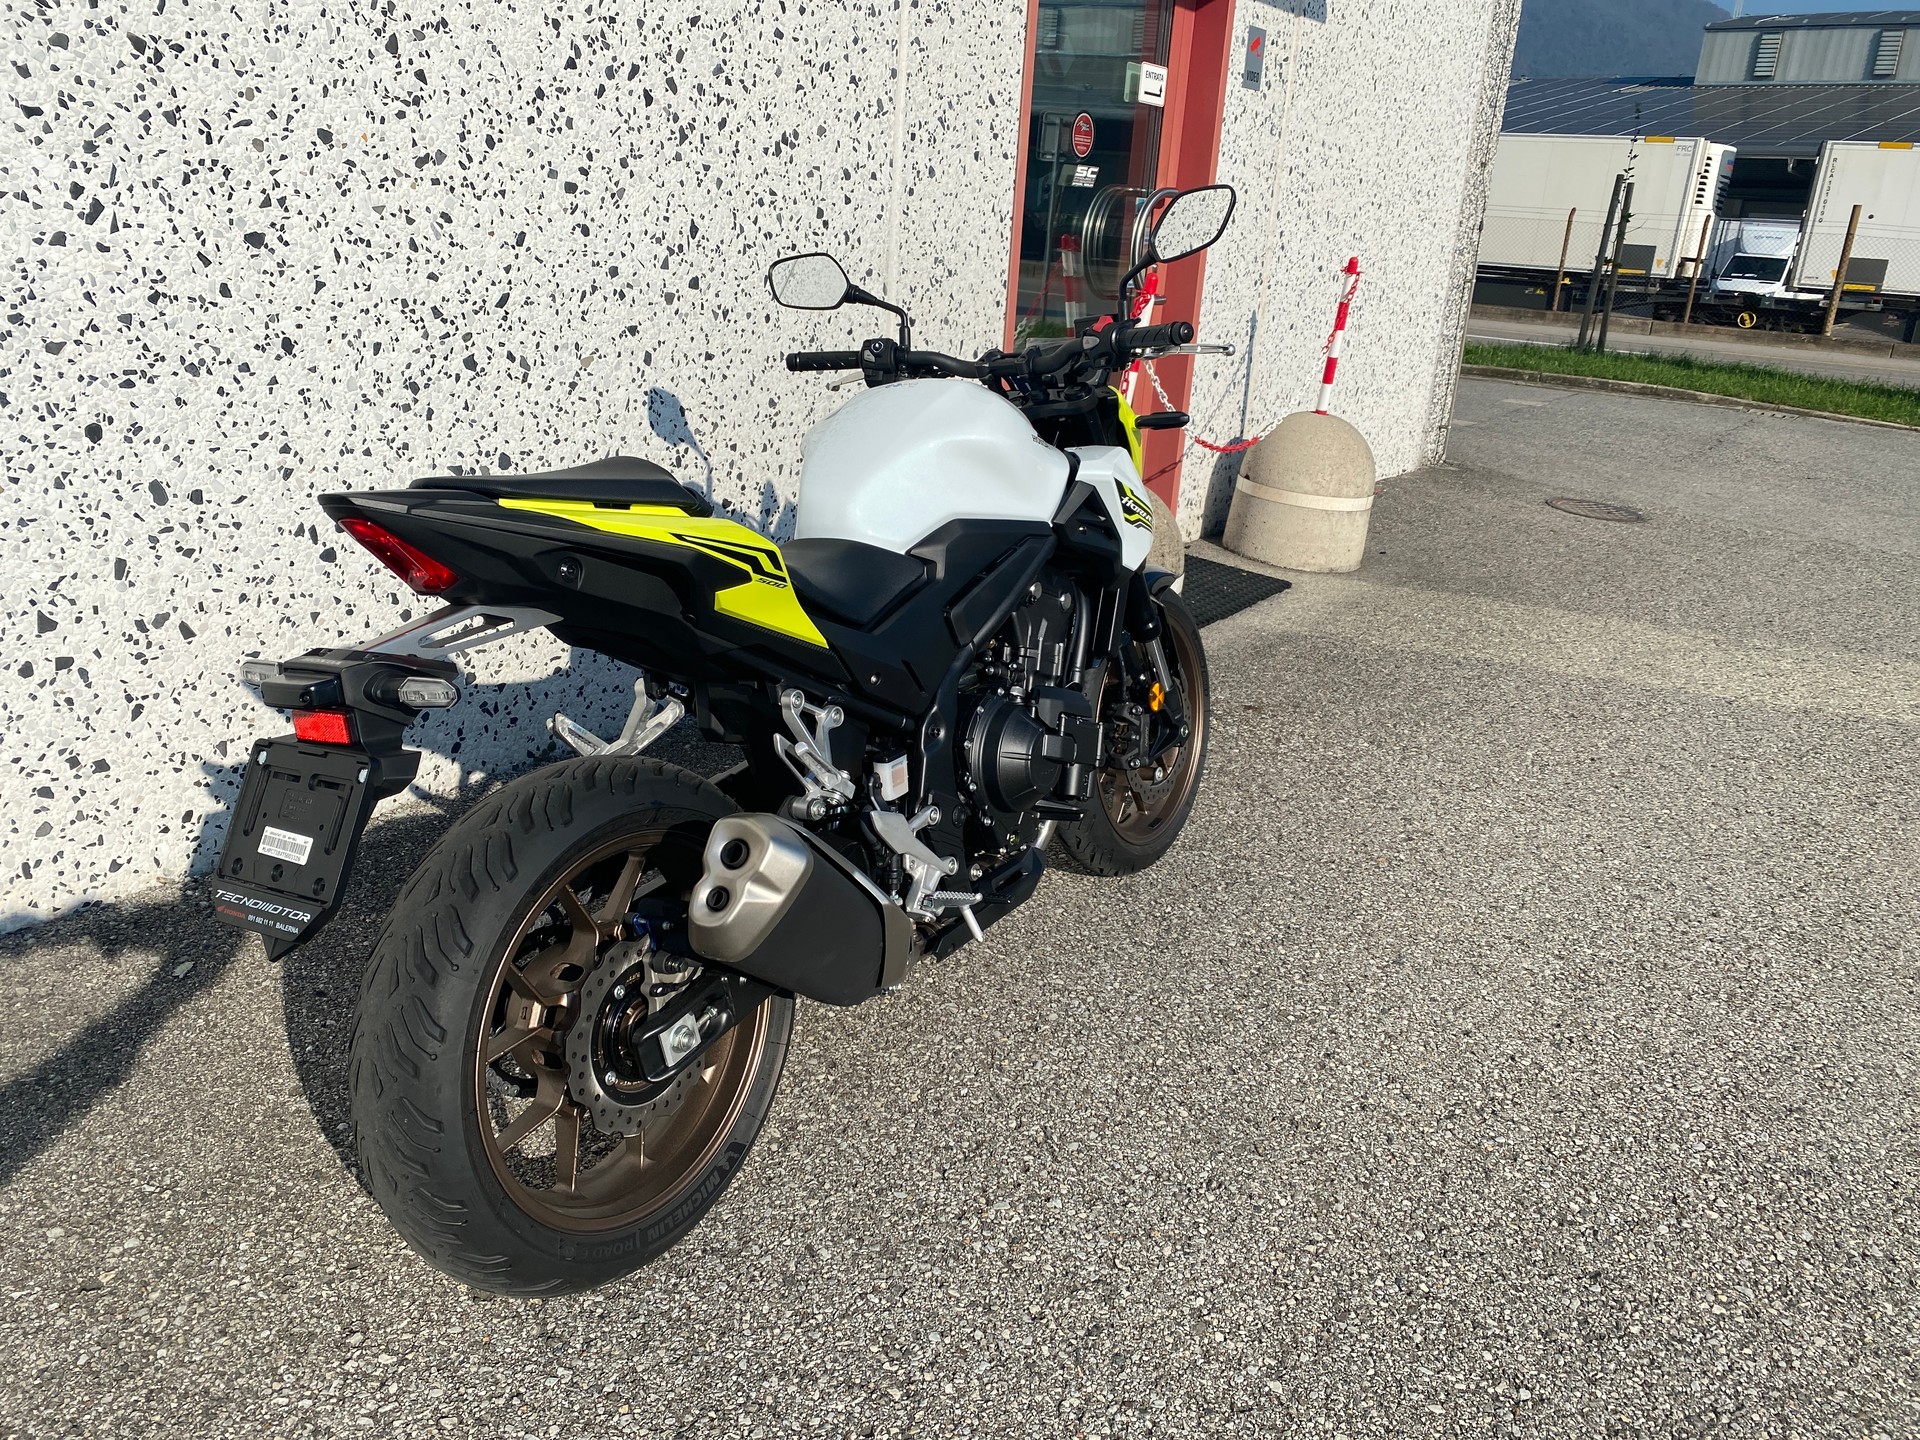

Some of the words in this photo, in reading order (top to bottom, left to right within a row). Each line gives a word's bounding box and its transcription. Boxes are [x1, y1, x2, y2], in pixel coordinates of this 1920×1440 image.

[1145, 70, 1164, 81] ENTRATA
[1076, 166, 1100, 178] SC
[755, 577, 788, 589] 500
[223, 908, 246, 920] HONDA
[275, 922, 299, 934] BALERNA
[646, 1169, 722, 1242] MICHELIN
[592, 1238, 633, 1258] ROAD
